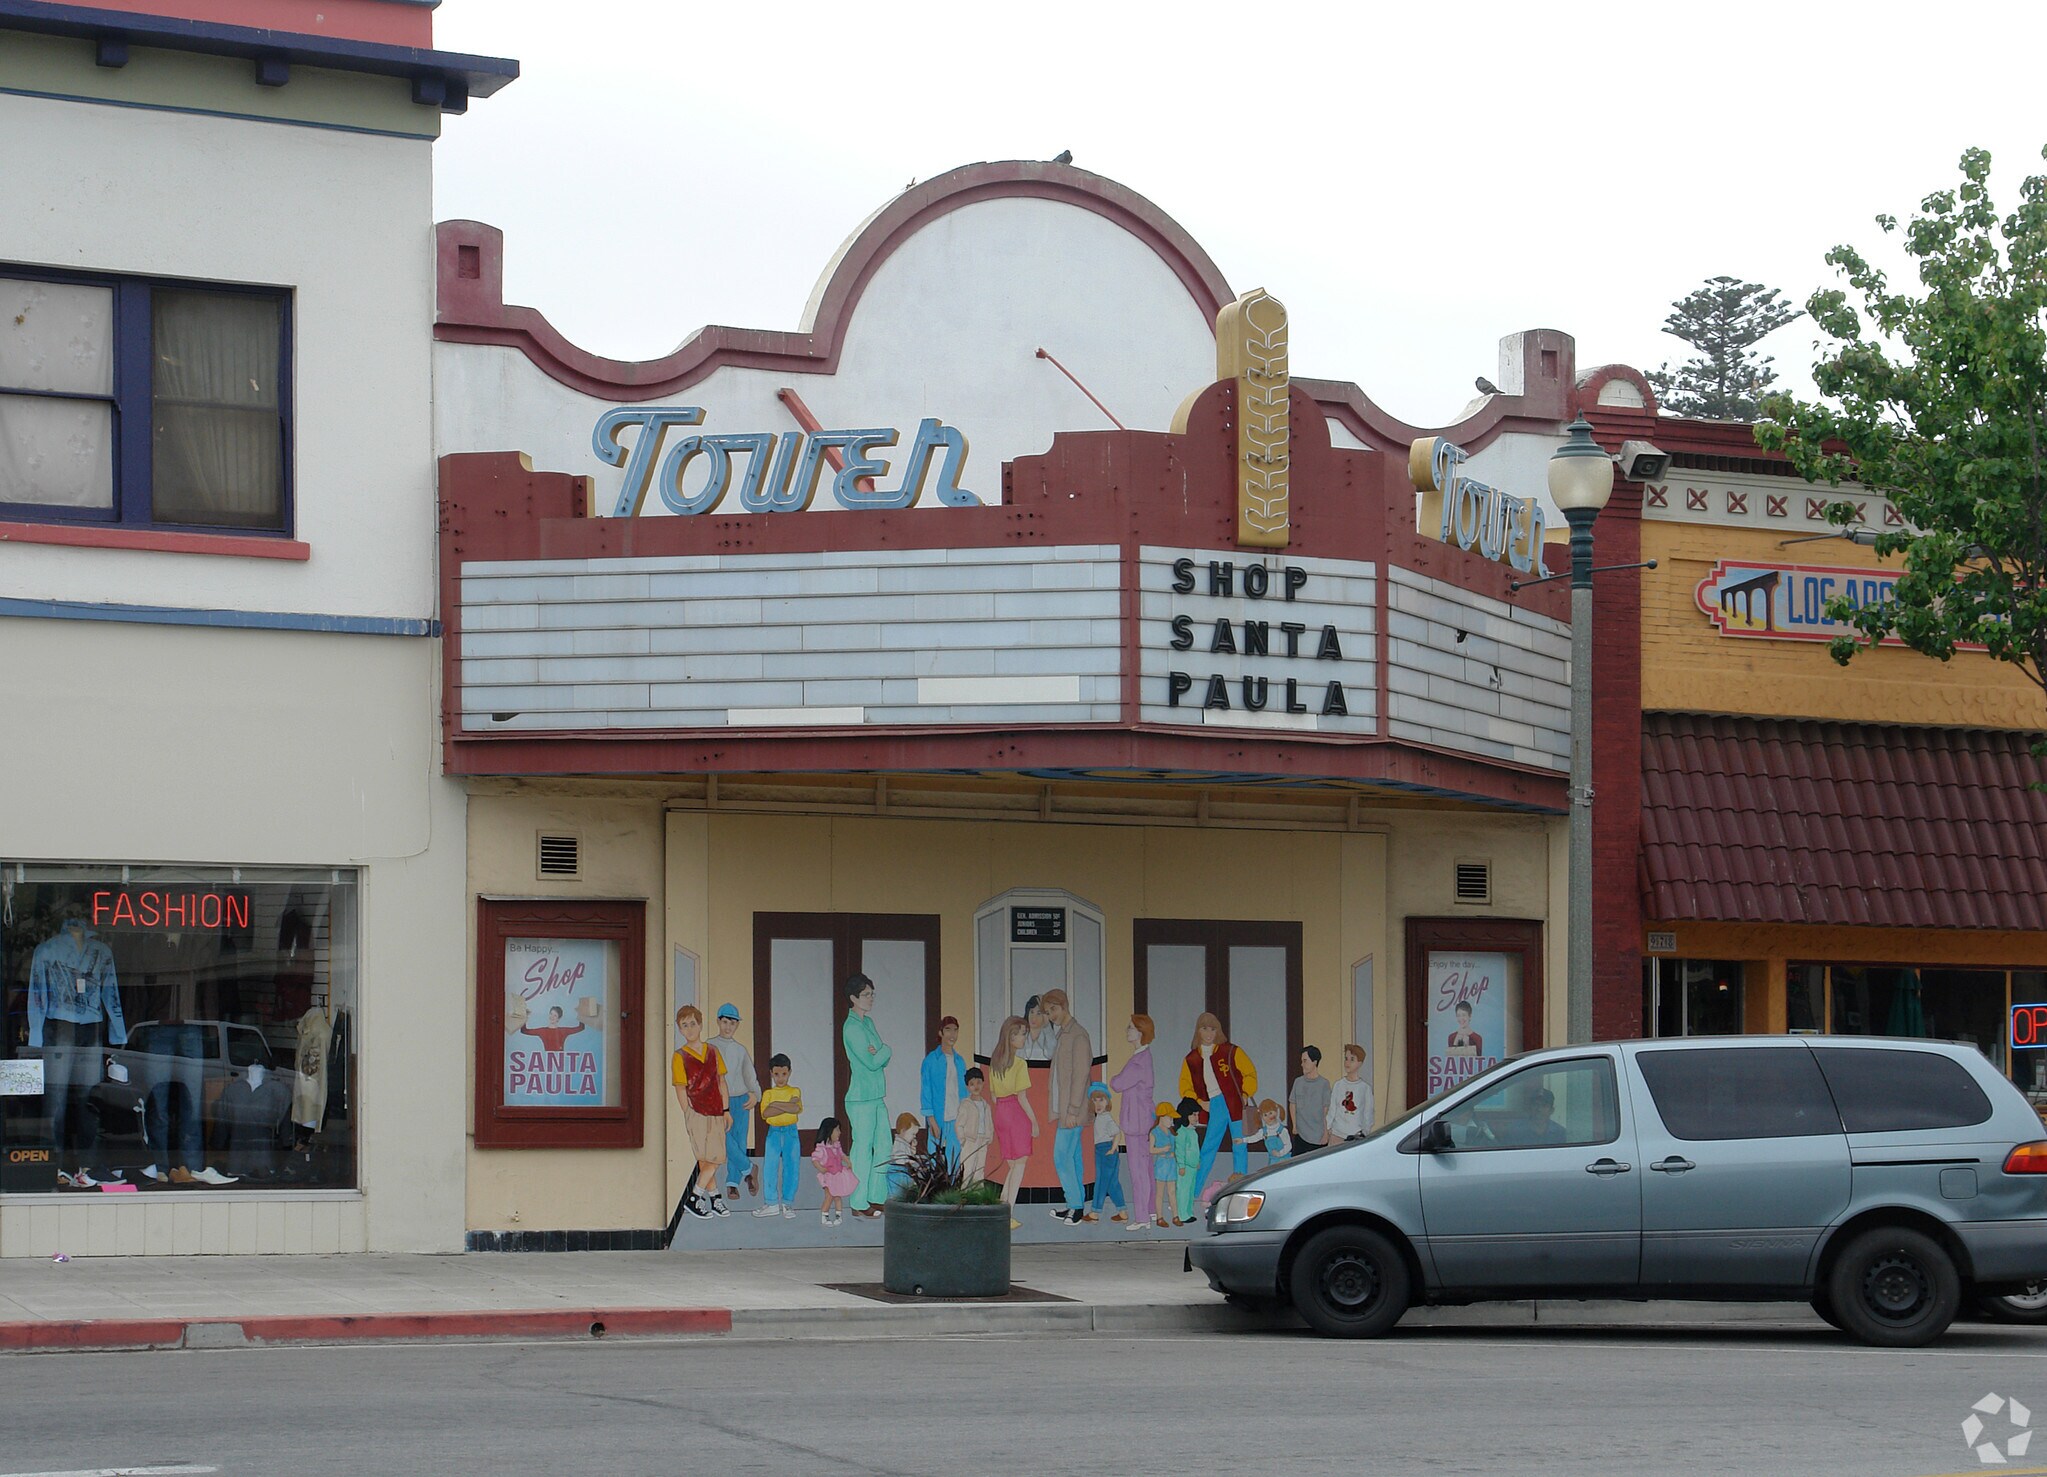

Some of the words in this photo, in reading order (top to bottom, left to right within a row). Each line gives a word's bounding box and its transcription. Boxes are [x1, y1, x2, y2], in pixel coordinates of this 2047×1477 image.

[1172, 557, 1307, 600] SHOP
[1787, 575, 1835, 626] LOS
[1170, 614, 1342, 660] SANTA
[1169, 671, 1348, 715] PAULA
[93, 892, 249, 928] FASHION
[509, 944, 522, 952] Be
[1429, 960, 1448, 969] Enjoy
[520, 956, 586, 1001] Shop
[1436, 970, 1490, 1012] Shop
[2013, 1007, 2047, 1044] OP
[509, 1051, 597, 1073] SANTA
[509, 1073, 597, 1095] PAULA
[9, 1150, 49, 1163] OPEN
